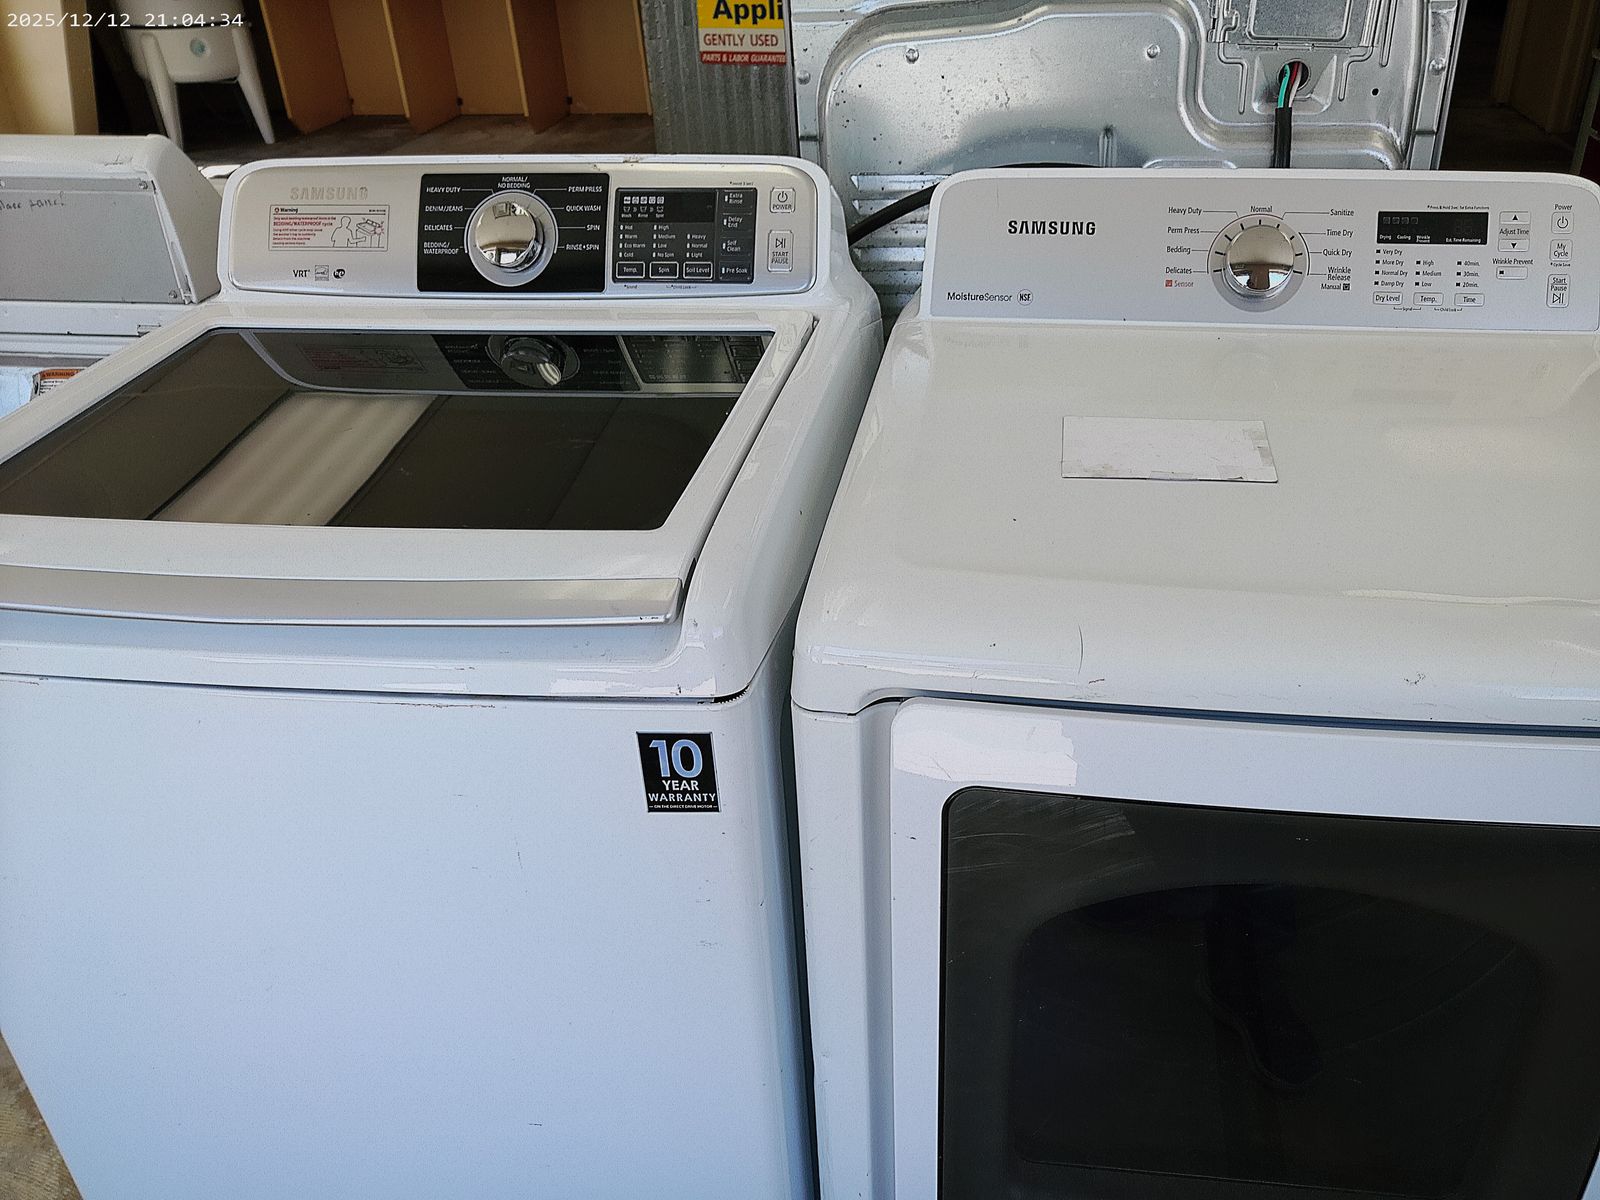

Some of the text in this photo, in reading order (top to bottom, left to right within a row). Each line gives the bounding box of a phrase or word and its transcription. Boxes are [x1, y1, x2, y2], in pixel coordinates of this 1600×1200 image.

[704, 34, 778, 46] GENTLY USED
[729, 54, 750, 62] LABOR
[290, 186, 368, 200] SAMSUNG
[1168, 207, 1202, 215] Heavy Duty
[1008, 220, 1096, 235] SAMSUNG
[1343, 230, 1353, 238] Dry
[1500, 228, 1516, 236] Adjust
[1167, 246, 1191, 255] Bedding
[1342, 249, 1352, 257] Dry
[947, 292, 1012, 302] MoistureSensor
[1019, 293, 1031, 301] NSF
[1375, 294, 1385, 302] Dry
[649, 739, 703, 778] 10
[662, 780, 699, 790] YEAR
[648, 793, 716, 801] WARRANTY
